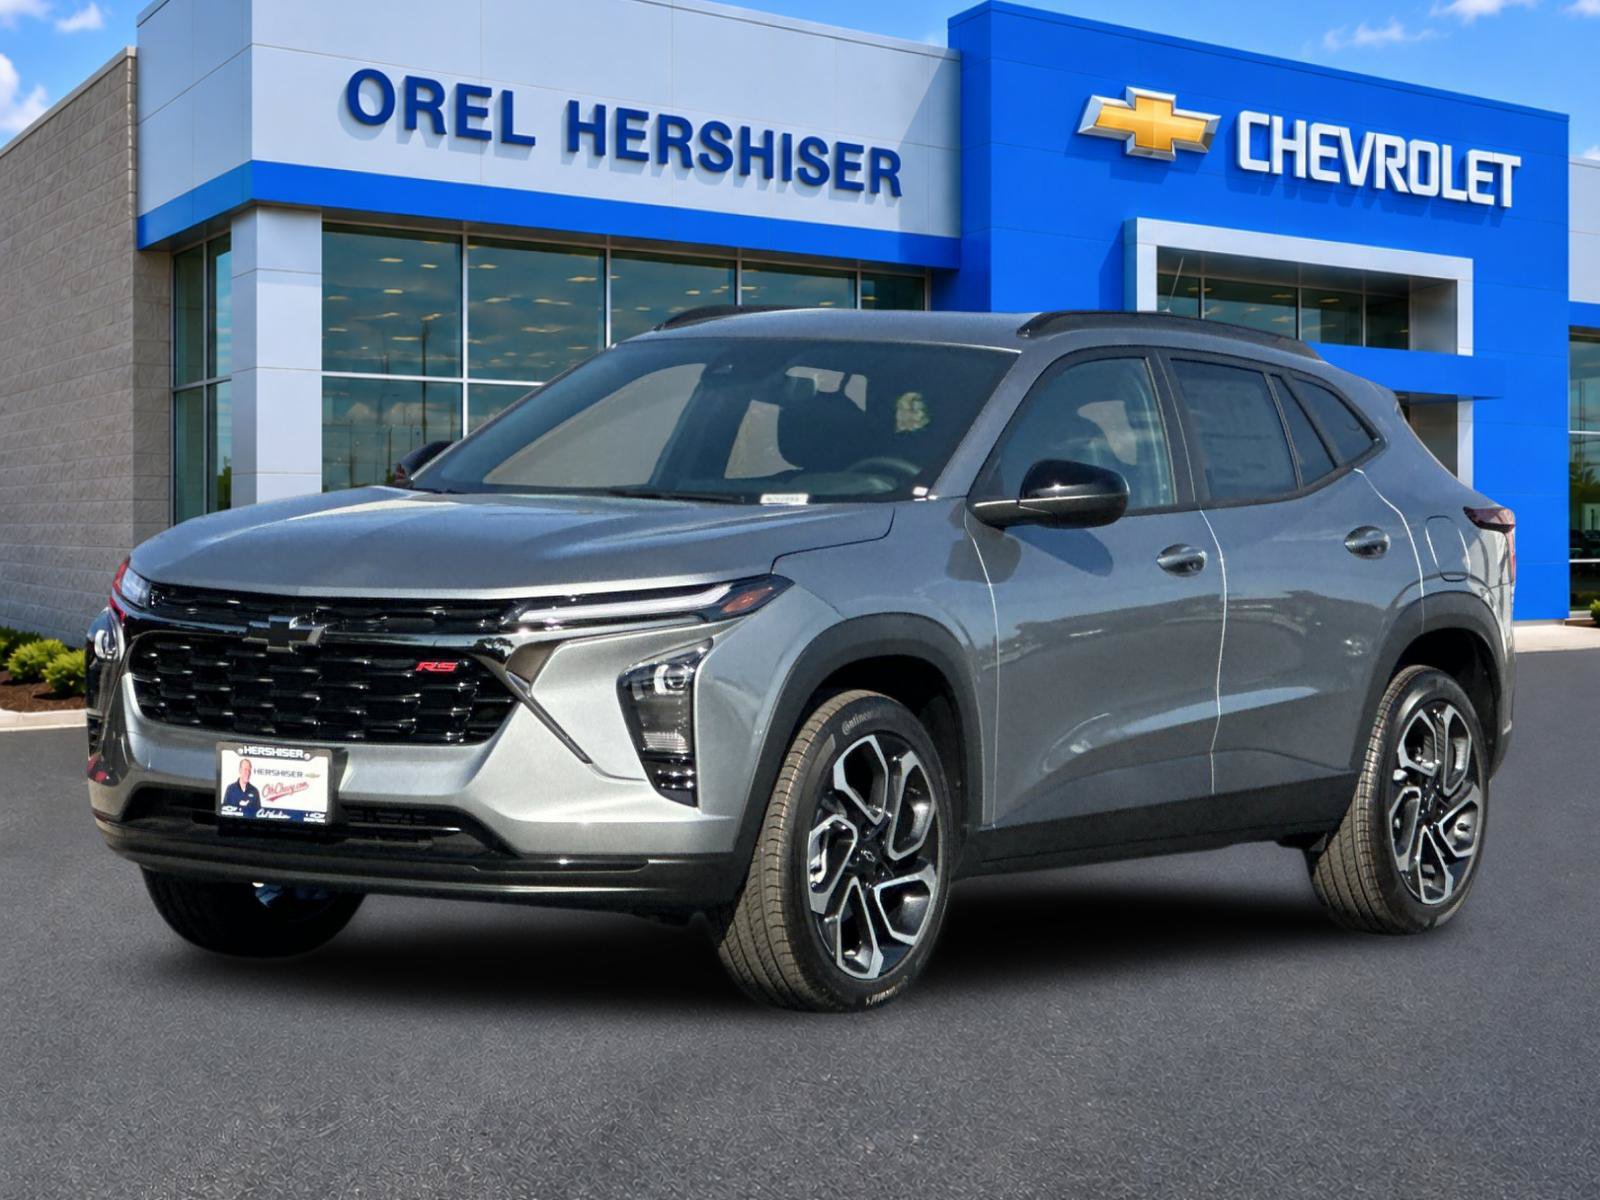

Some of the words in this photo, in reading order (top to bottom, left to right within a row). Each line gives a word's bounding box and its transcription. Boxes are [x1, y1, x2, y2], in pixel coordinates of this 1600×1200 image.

[346, 68, 536, 147] OREL
[566, 99, 902, 198] HERSHISER
[1237, 109, 1522, 208] CHEVROLET
[415, 661, 459, 672] RS
[243, 745, 304, 759] HERSHISER
[253, 767, 304, 779] HERSHISER
